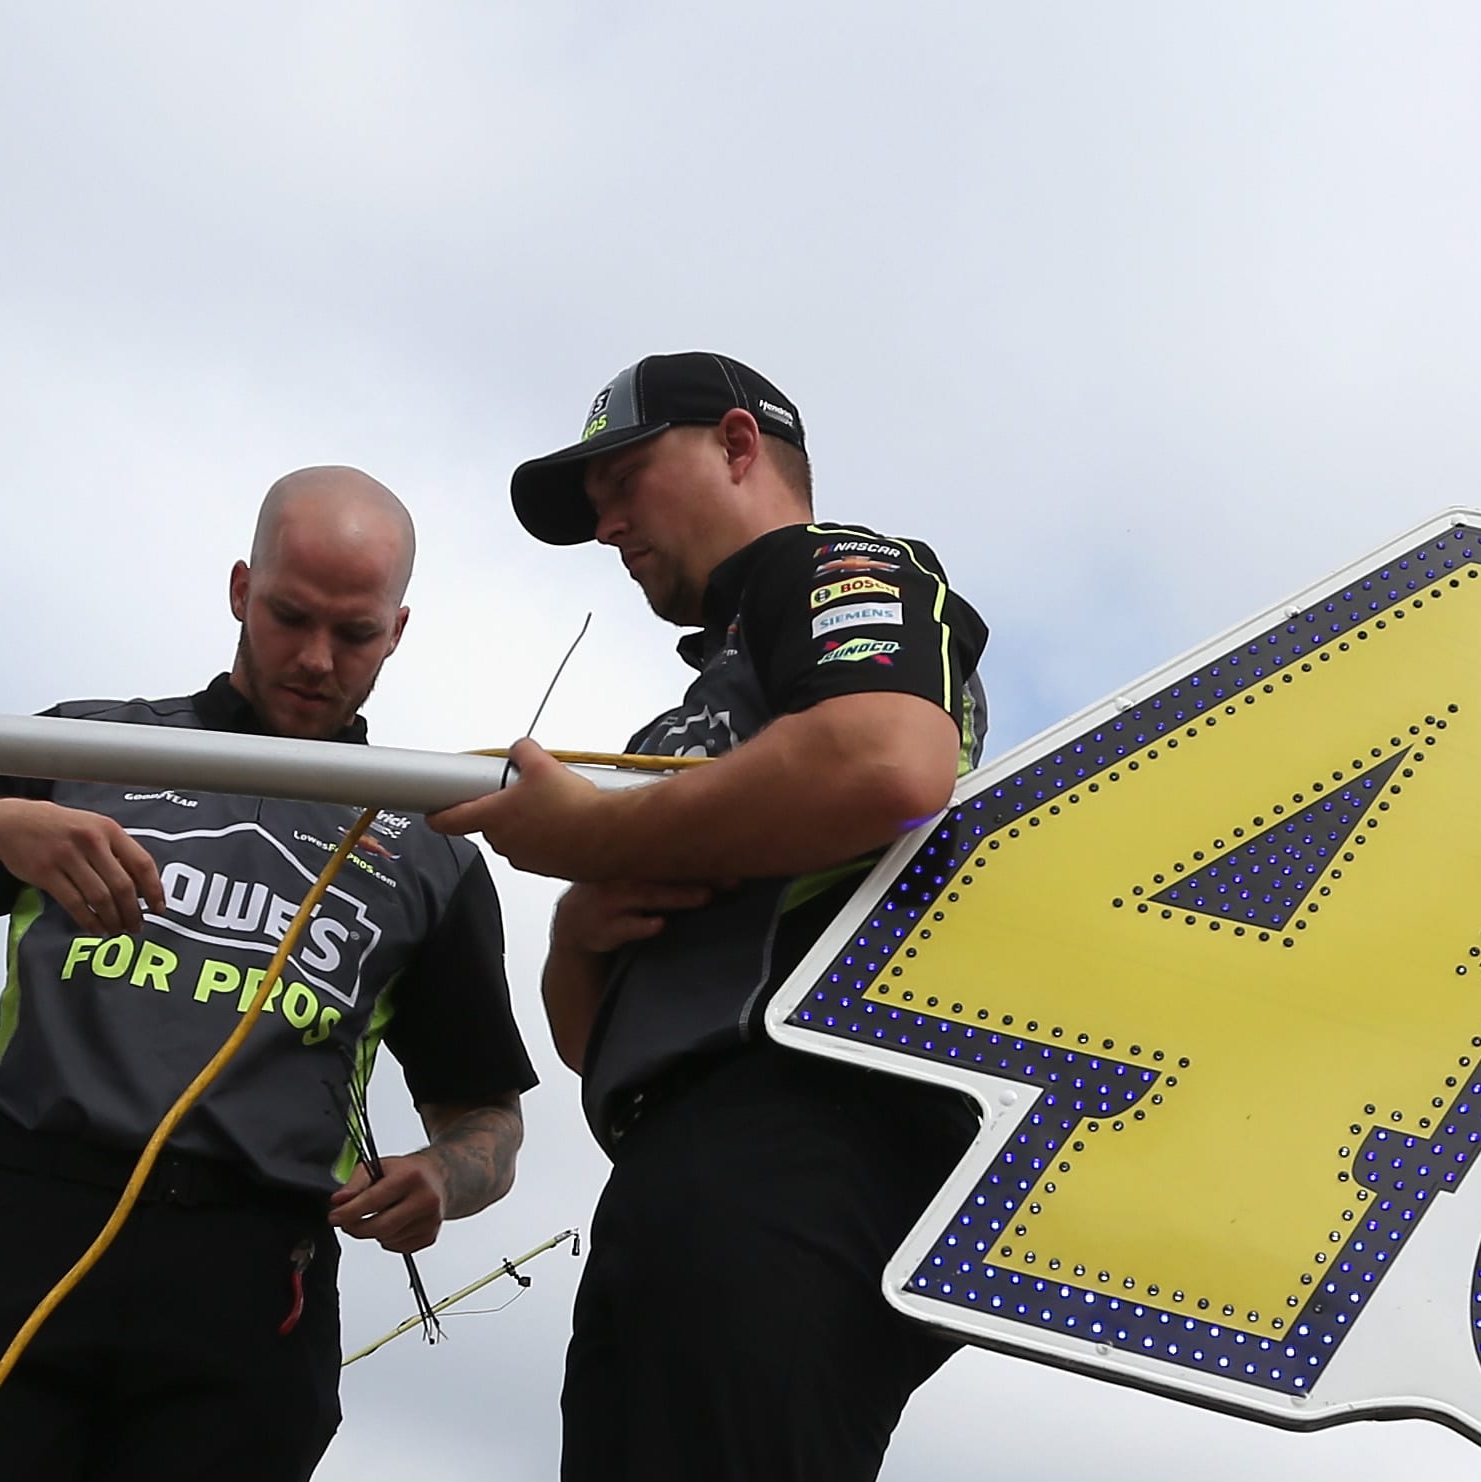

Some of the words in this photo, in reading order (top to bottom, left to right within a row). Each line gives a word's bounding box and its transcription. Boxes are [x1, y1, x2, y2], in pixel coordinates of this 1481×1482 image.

[833, 541, 901, 558] NASCAR
[819, 608, 894, 629] SIEMENS
[60, 933, 179, 993] FOR
[192, 958, 342, 1046] PROS
